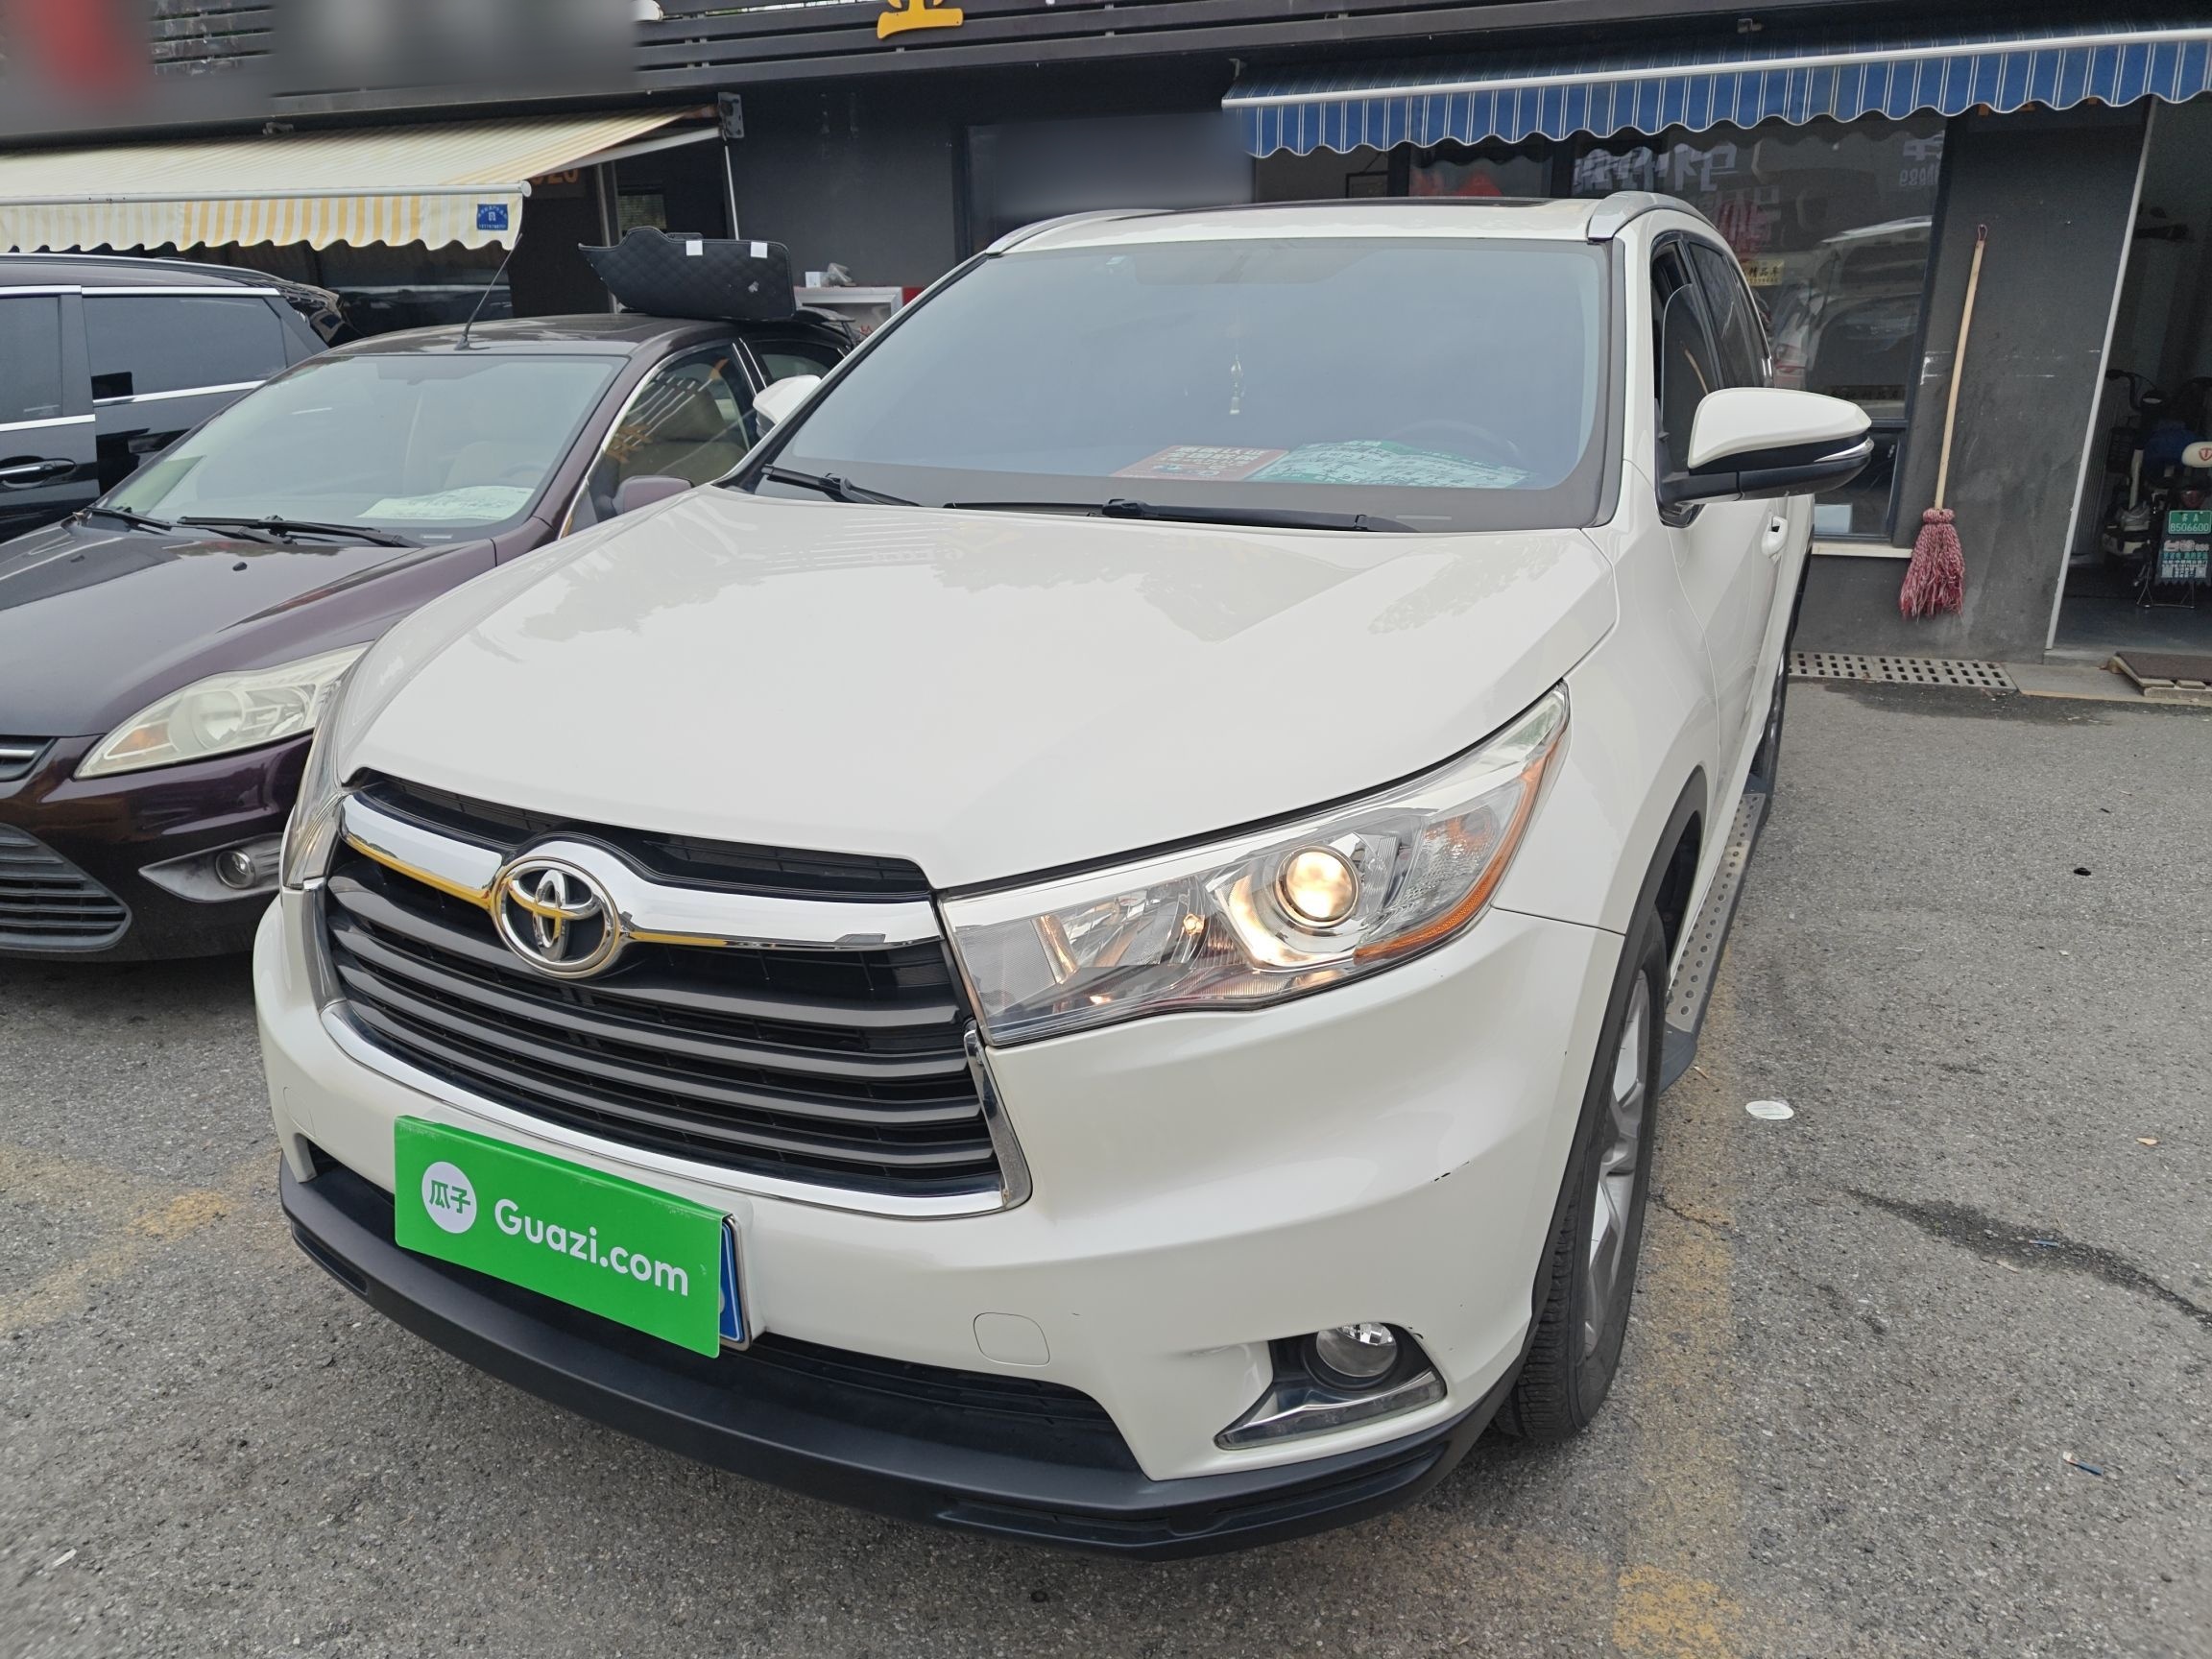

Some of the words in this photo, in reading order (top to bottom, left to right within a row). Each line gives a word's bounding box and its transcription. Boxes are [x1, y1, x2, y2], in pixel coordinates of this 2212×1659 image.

[2170, 522, 2209, 532] 8506600
[429, 1179, 471, 1214] 瓜子
[494, 1198, 689, 1297] Guazi.com
